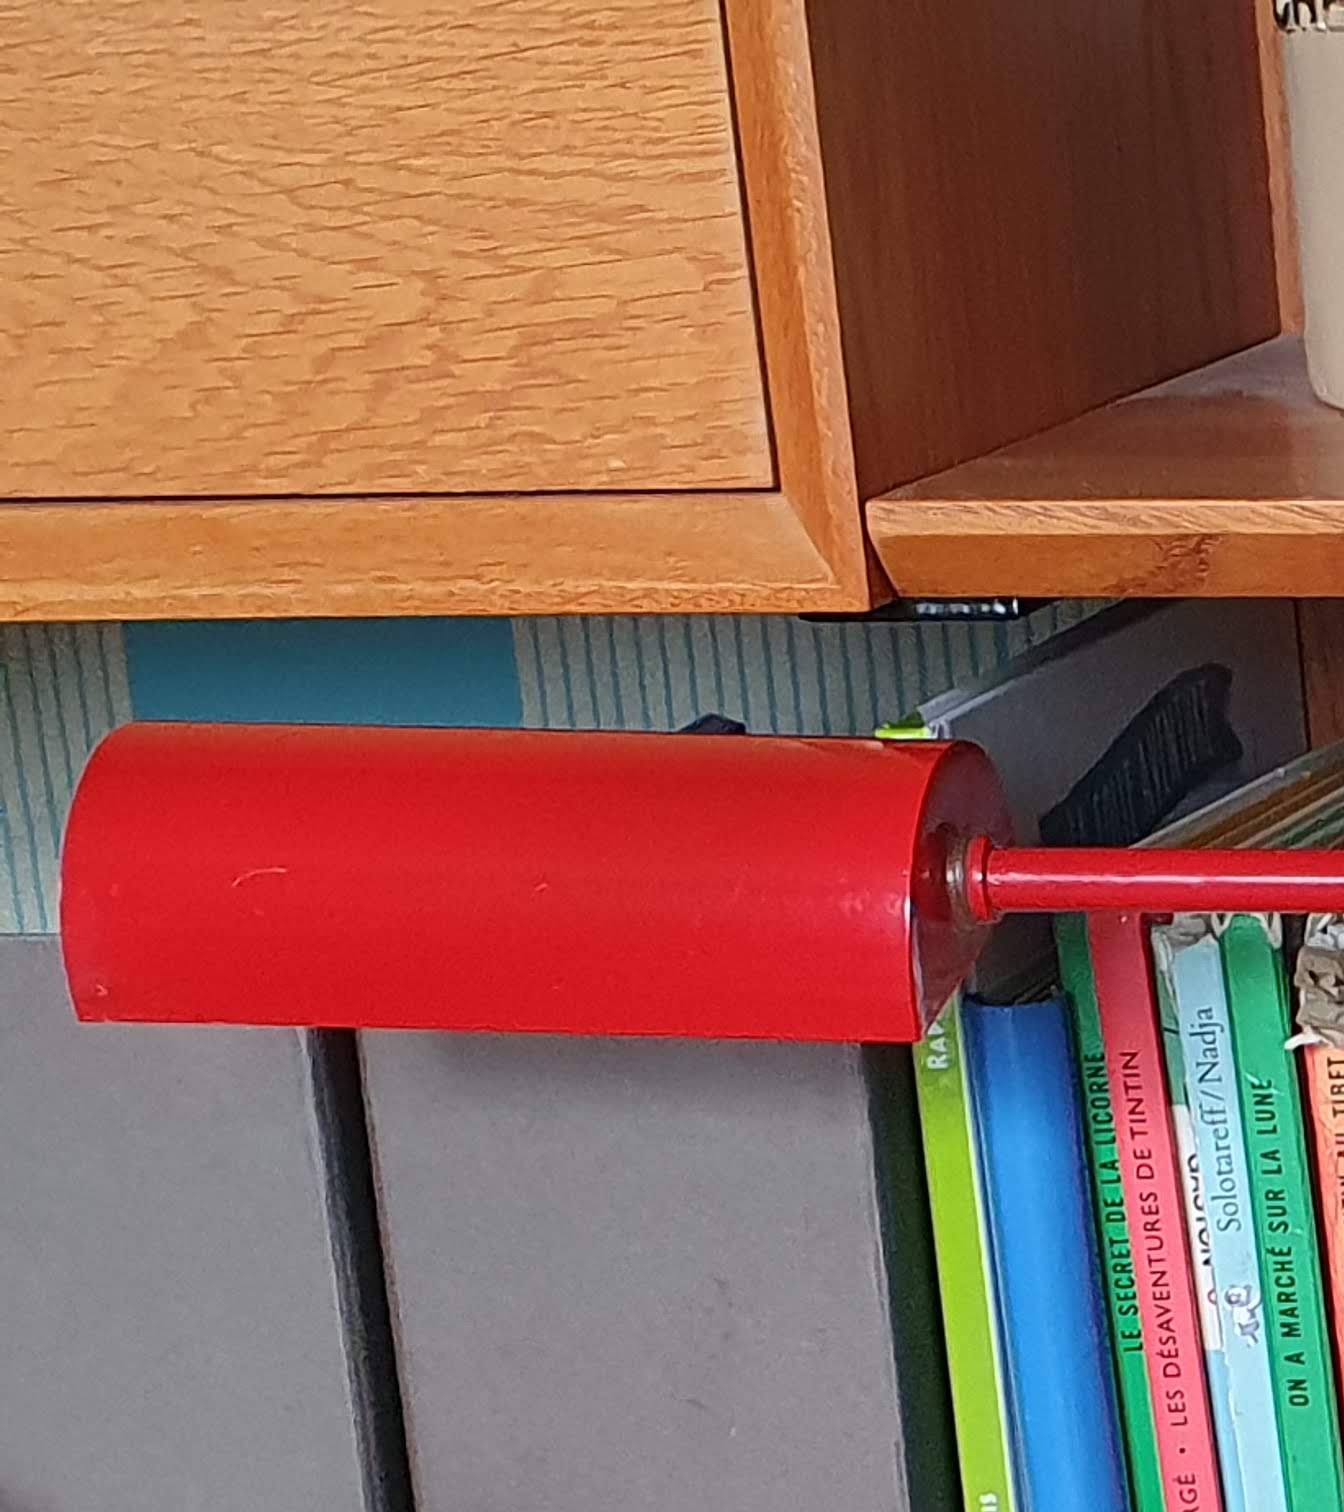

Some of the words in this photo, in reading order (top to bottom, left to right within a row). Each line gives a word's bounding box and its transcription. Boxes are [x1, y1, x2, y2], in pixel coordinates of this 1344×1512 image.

[1082, 1052, 1115, 1146] LICORNE
[1119, 1051, 1150, 1140] TINTIN
[1251, 1077, 1278, 1134] LUNE
[1098, 1159, 1120, 1185] LA
[1133, 1148, 1155, 1182] DE
[1260, 1148, 1282, 1174] LA
[1103, 1196, 1126, 1223] DE
[1264, 1188, 1289, 1234] SUR
[1108, 1237, 1138, 1317] SECRET
[1137, 1191, 1182, 1379] DÉSAVENTURES
[1266, 1245, 1301, 1339] MARCHÉ
[1120, 1329, 1143, 1353] LE
[1165, 1388, 1188, 1427] LES
[1287, 1377, 1309, 1407] ON
